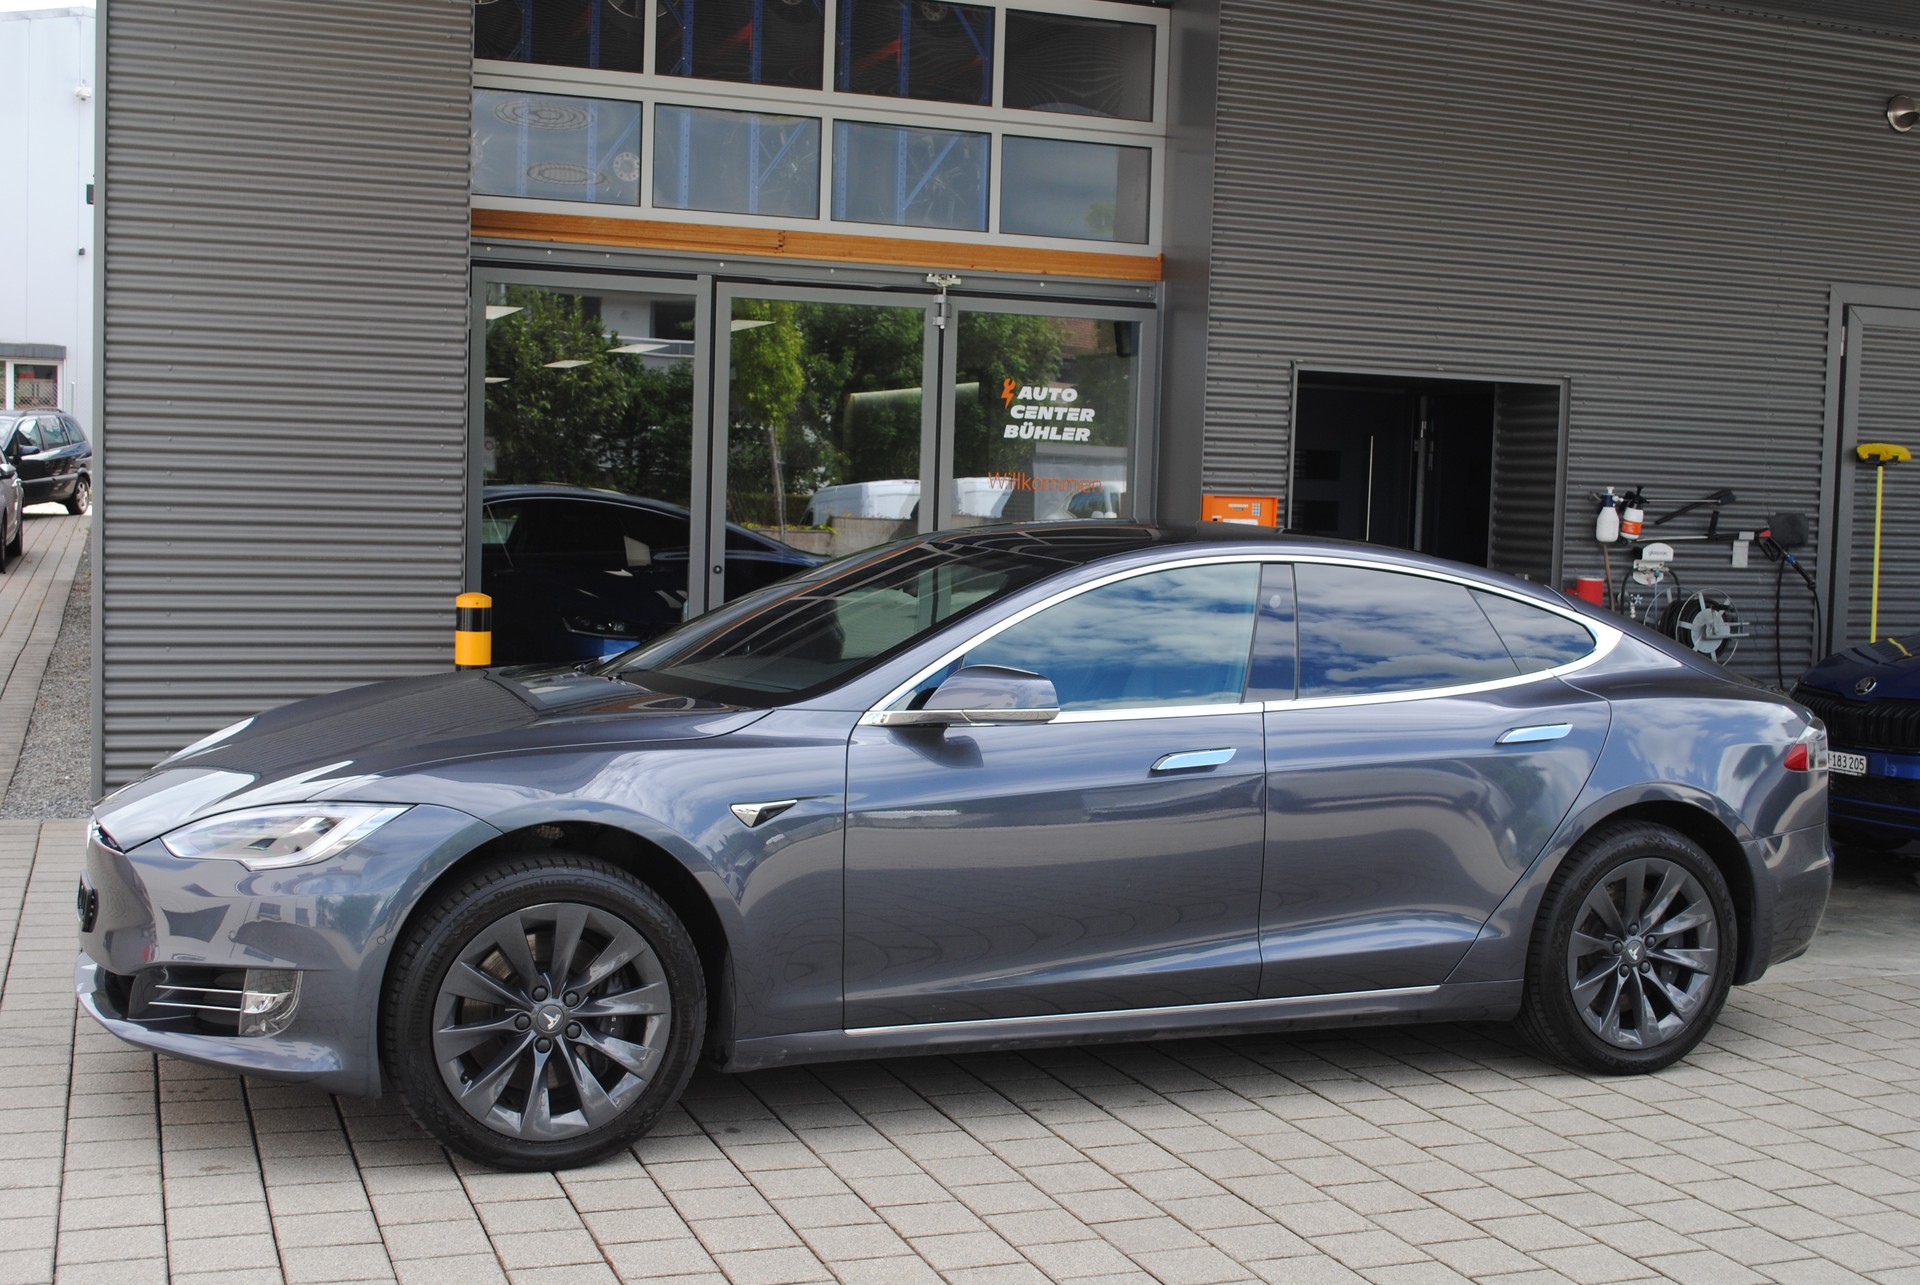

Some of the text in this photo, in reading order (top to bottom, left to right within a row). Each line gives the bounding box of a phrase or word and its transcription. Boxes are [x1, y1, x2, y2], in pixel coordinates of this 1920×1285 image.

[1017, 386, 1078, 402] AUTO
[1010, 405, 1096, 422] CENTER
[1003, 421, 1091, 441] BÜHLER
[988, 471, 1103, 493] Willkommen
[1849, 757, 1865, 771] 205
